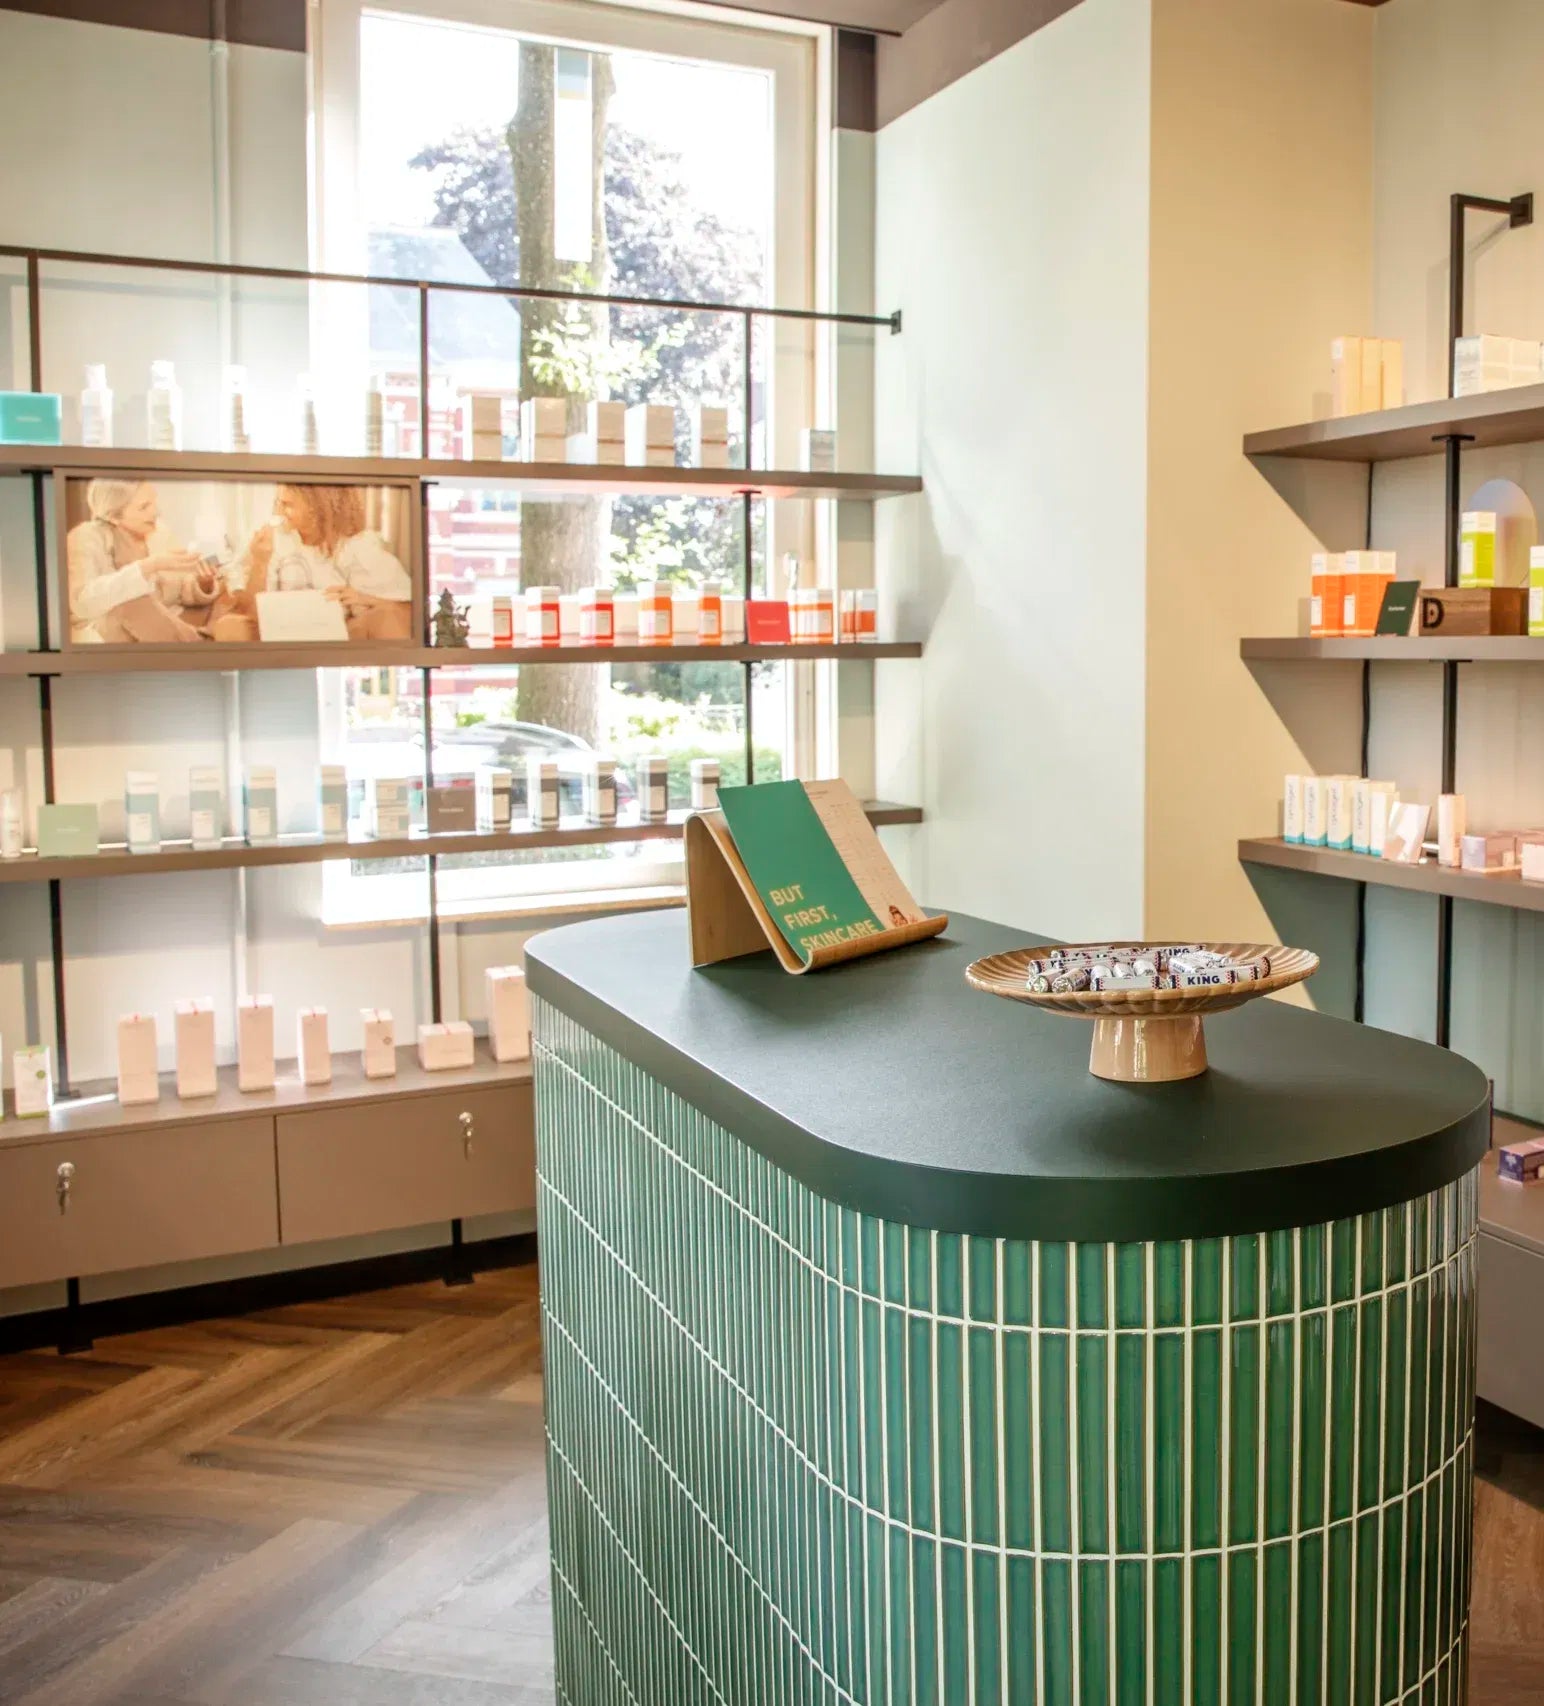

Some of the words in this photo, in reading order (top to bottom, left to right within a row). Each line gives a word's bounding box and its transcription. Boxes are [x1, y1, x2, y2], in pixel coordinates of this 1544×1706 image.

[769, 885, 804, 906] BUT
[784, 905, 837, 930] FIRST,
[800, 920, 879, 950] SKINCARE
[1187, 976, 1220, 985] KING
